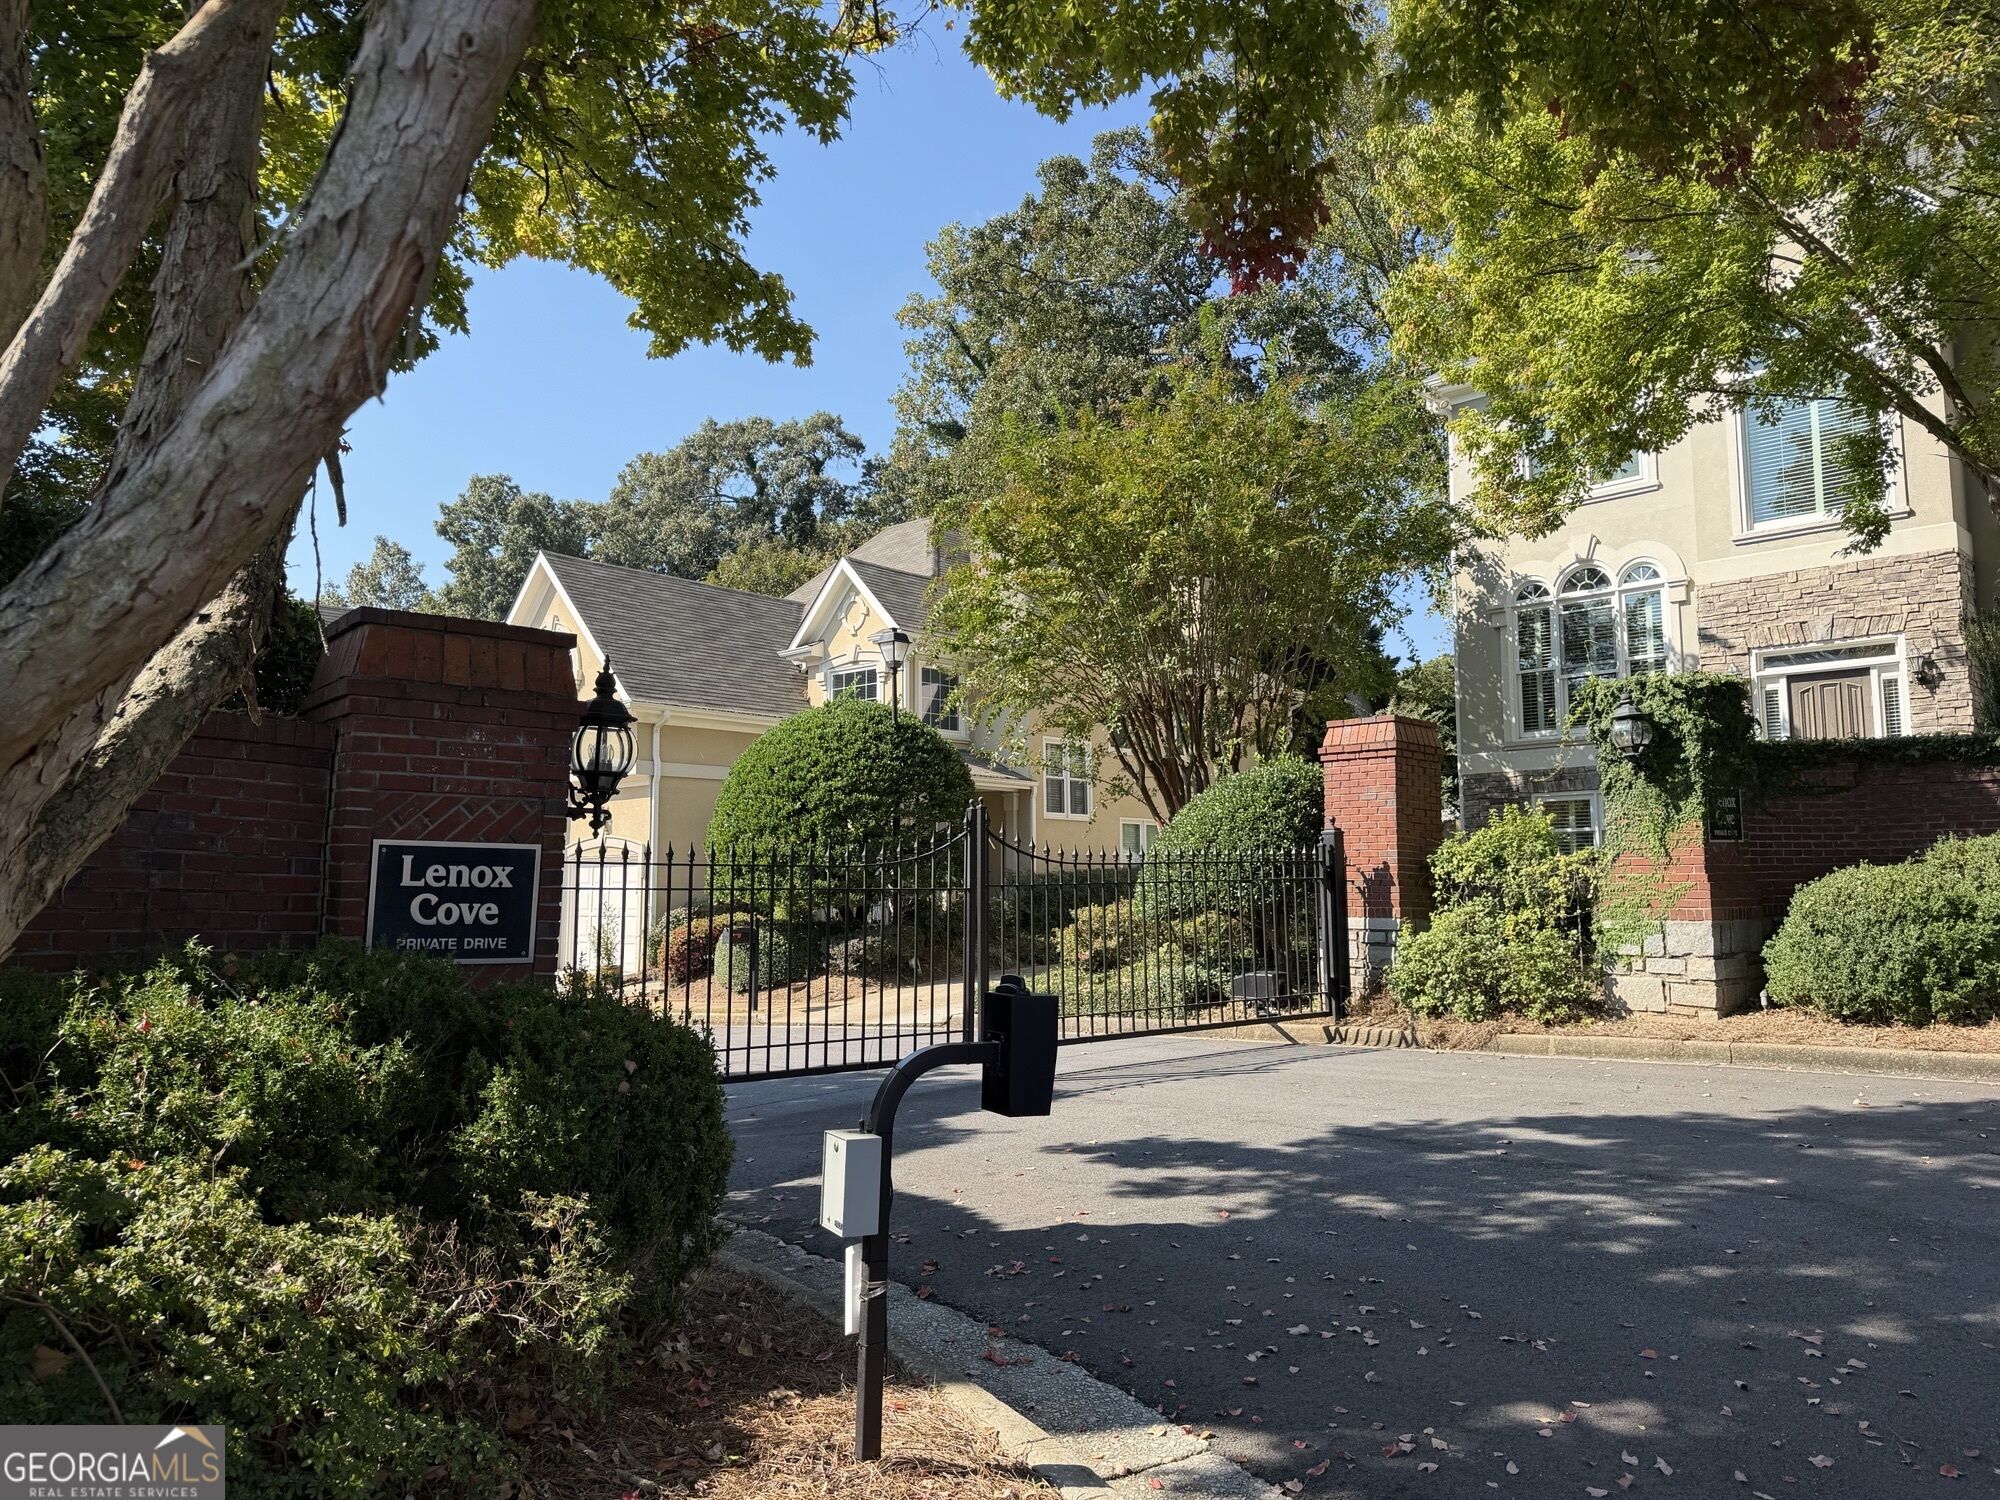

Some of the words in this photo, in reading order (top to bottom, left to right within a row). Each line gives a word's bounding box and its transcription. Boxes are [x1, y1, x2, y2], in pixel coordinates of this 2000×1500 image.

[399, 854, 514, 888] Lenox
[409, 892, 500, 926] Cove
[396, 937, 458, 950] PRIVATE
[463, 937, 507, 950] DRIVE
